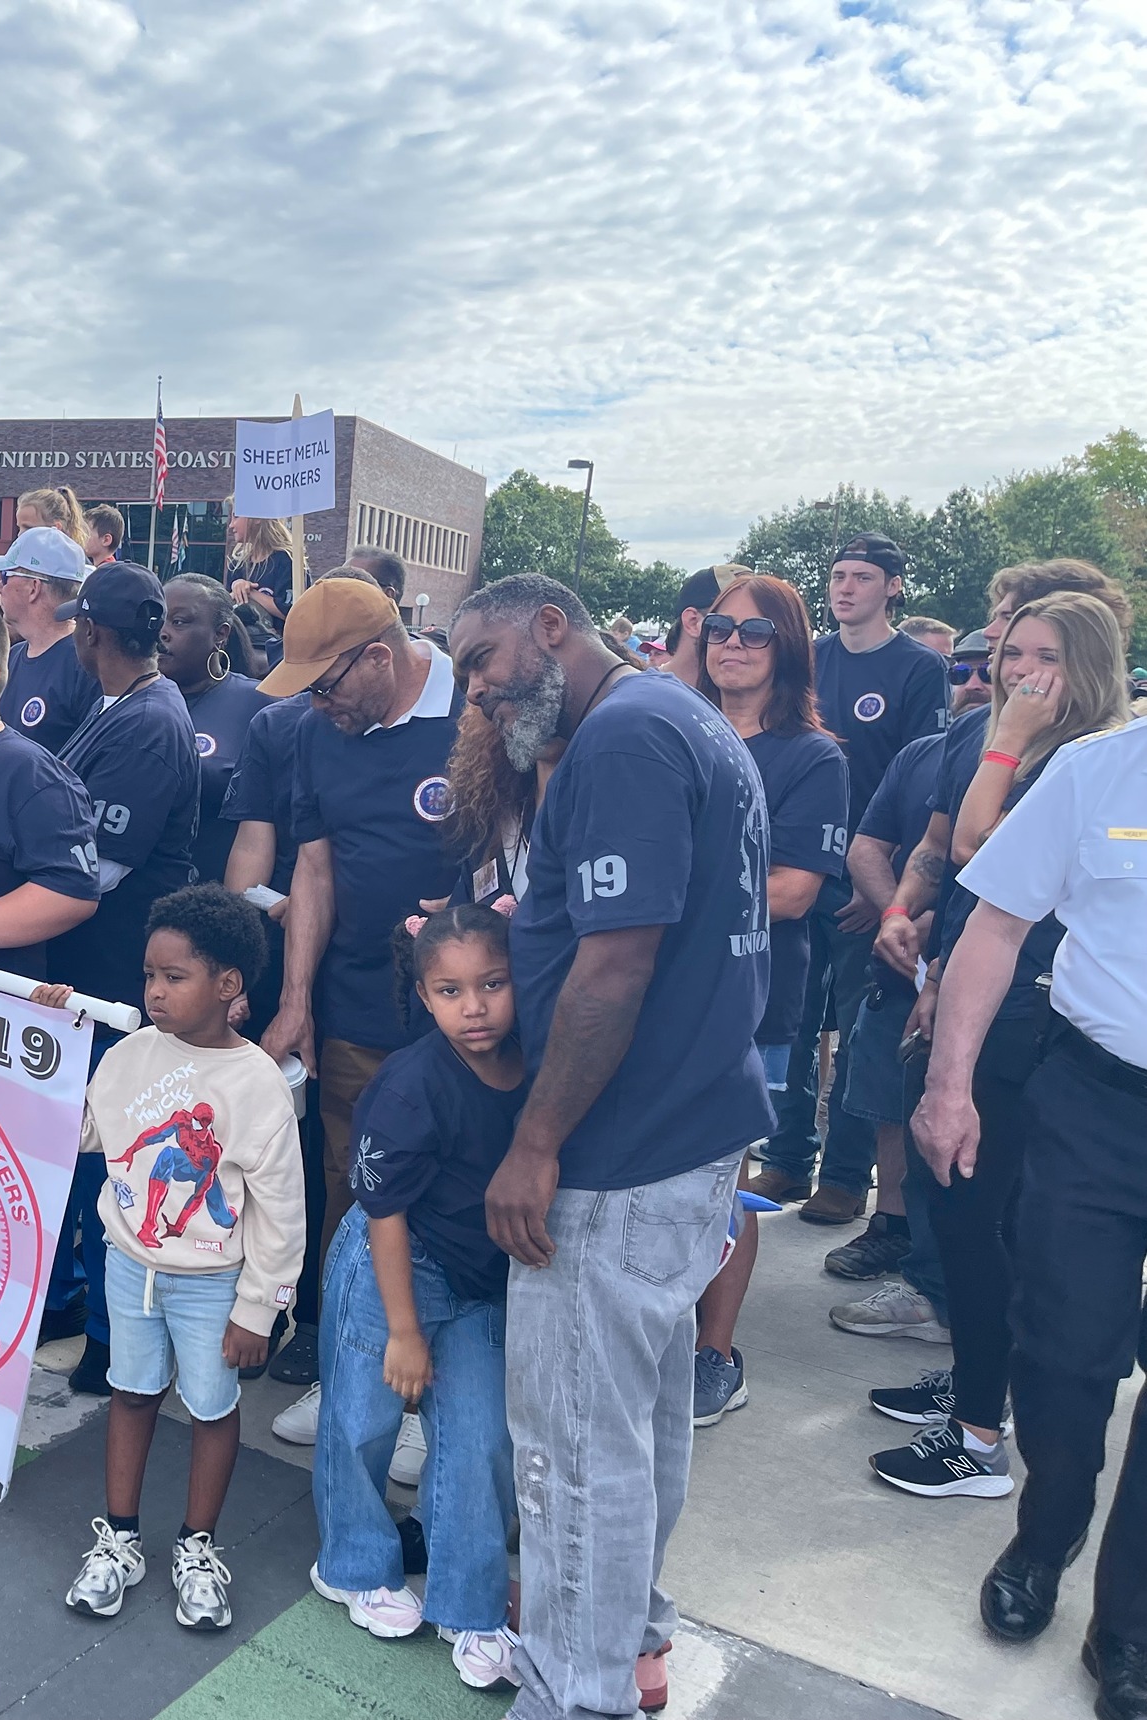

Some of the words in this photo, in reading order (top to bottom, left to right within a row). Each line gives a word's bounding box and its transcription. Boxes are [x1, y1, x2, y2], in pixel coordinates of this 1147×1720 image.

[74, 451, 154, 468] STATES
[164, 451, 236, 468] COAST
[242, 447, 292, 465] SHEET
[294, 439, 330, 462] METAL
[254, 467, 321, 491] WORKERS
[93, 799, 131, 835] 19
[821, 823, 848, 857] 19
[69, 841, 100, 874] 19
[577, 854, 628, 903] 19
[153, 1060, 199, 1094] YORK
[195, 1239, 222, 1254] MARVEL
[943, 1455, 980, 1479] N
